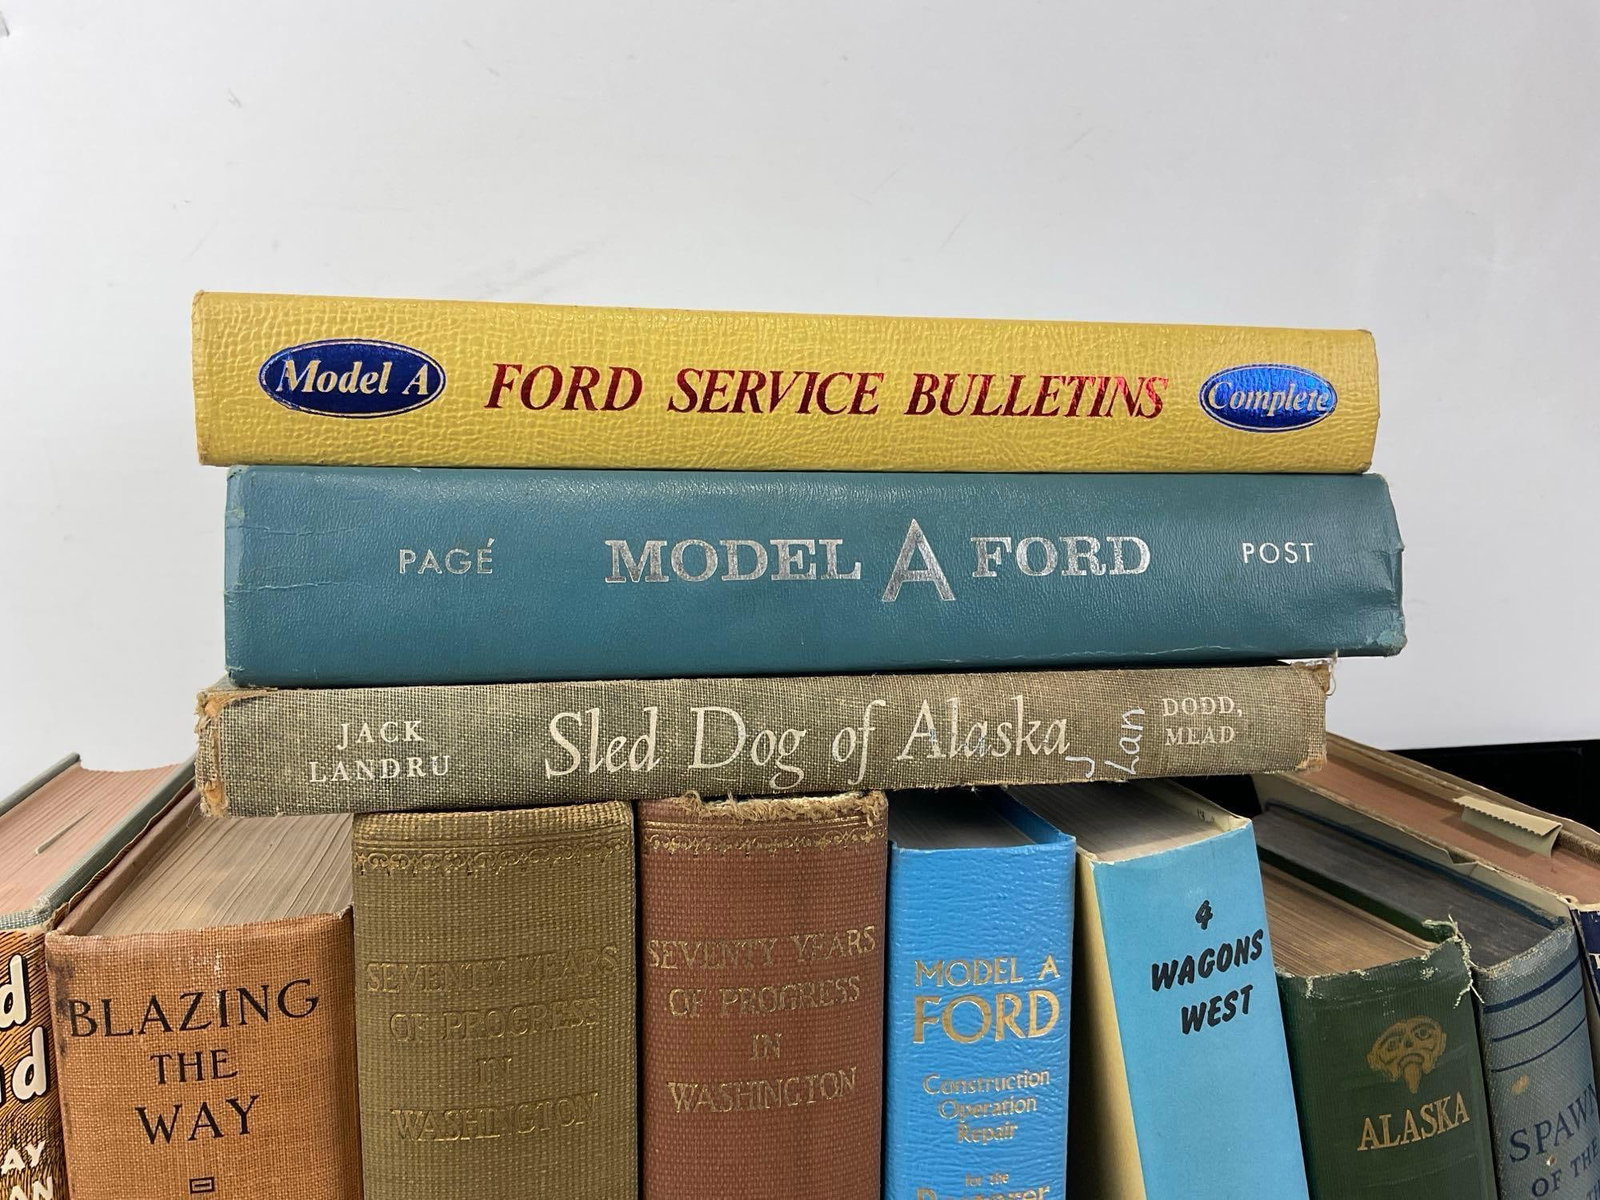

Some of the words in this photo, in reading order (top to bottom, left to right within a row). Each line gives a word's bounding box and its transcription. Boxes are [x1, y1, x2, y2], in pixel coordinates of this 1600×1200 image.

[275, 360, 391, 396] Model
[401, 361, 430, 396] A
[484, 361, 643, 412] FORD
[667, 367, 884, 416] SERVICE
[903, 372, 1169, 420] BULLETINS
[1208, 379, 1333, 419] Complete
[399, 538, 495, 575] PAGÉ
[604, 538, 862, 584] MODEL
[881, 518, 956, 602] A
[970, 535, 1151, 578] FORD
[1242, 542, 1314, 565] POST
[1161, 696, 1243, 718] DODD,
[336, 719, 426, 750] JACK
[543, 706, 661, 779] Sled
[687, 705, 808, 790] Dog
[831, 699, 886, 786] of
[893, 695, 1071, 761] Alaska
[1164, 725, 1237, 747] MEAD
[308, 755, 451, 784] LANDRU
[1194, 900, 1214, 931] 4
[647, 937, 778, 970] SEVENTY
[792, 925, 877, 962] YEARS
[1151, 928, 1264, 992] WAGONS
[914, 956, 1024, 987] MODEL
[1038, 955, 1061, 980] A
[67, 978, 320, 1038] BLAZING
[668, 987, 707, 1018] OF
[719, 974, 861, 1016] PROGRESS
[1180, 984, 1254, 1035] WEST
[389, 1011, 430, 1042] OF
[442, 998, 601, 1041] PROGRESS
[913, 989, 1061, 1044] FORD
[750, 1032, 783, 1061] IN
[150, 1049, 239, 1085] THE
[476, 1055, 513, 1088] IN
[922, 1069, 1050, 1095] Construction
[666, 1066, 857, 1114] WASHINGTON
[938, 1096, 1037, 1123] Operation
[134, 1095, 261, 1145] WAY
[389, 1092, 600, 1142] WASHINGTON
[956, 1121, 1019, 1145] Repair
[1356, 1091, 1471, 1151] ALASKA
[1531, 1168, 1562, 1198] OF
[1570, 1137, 1600, 1178] THE
